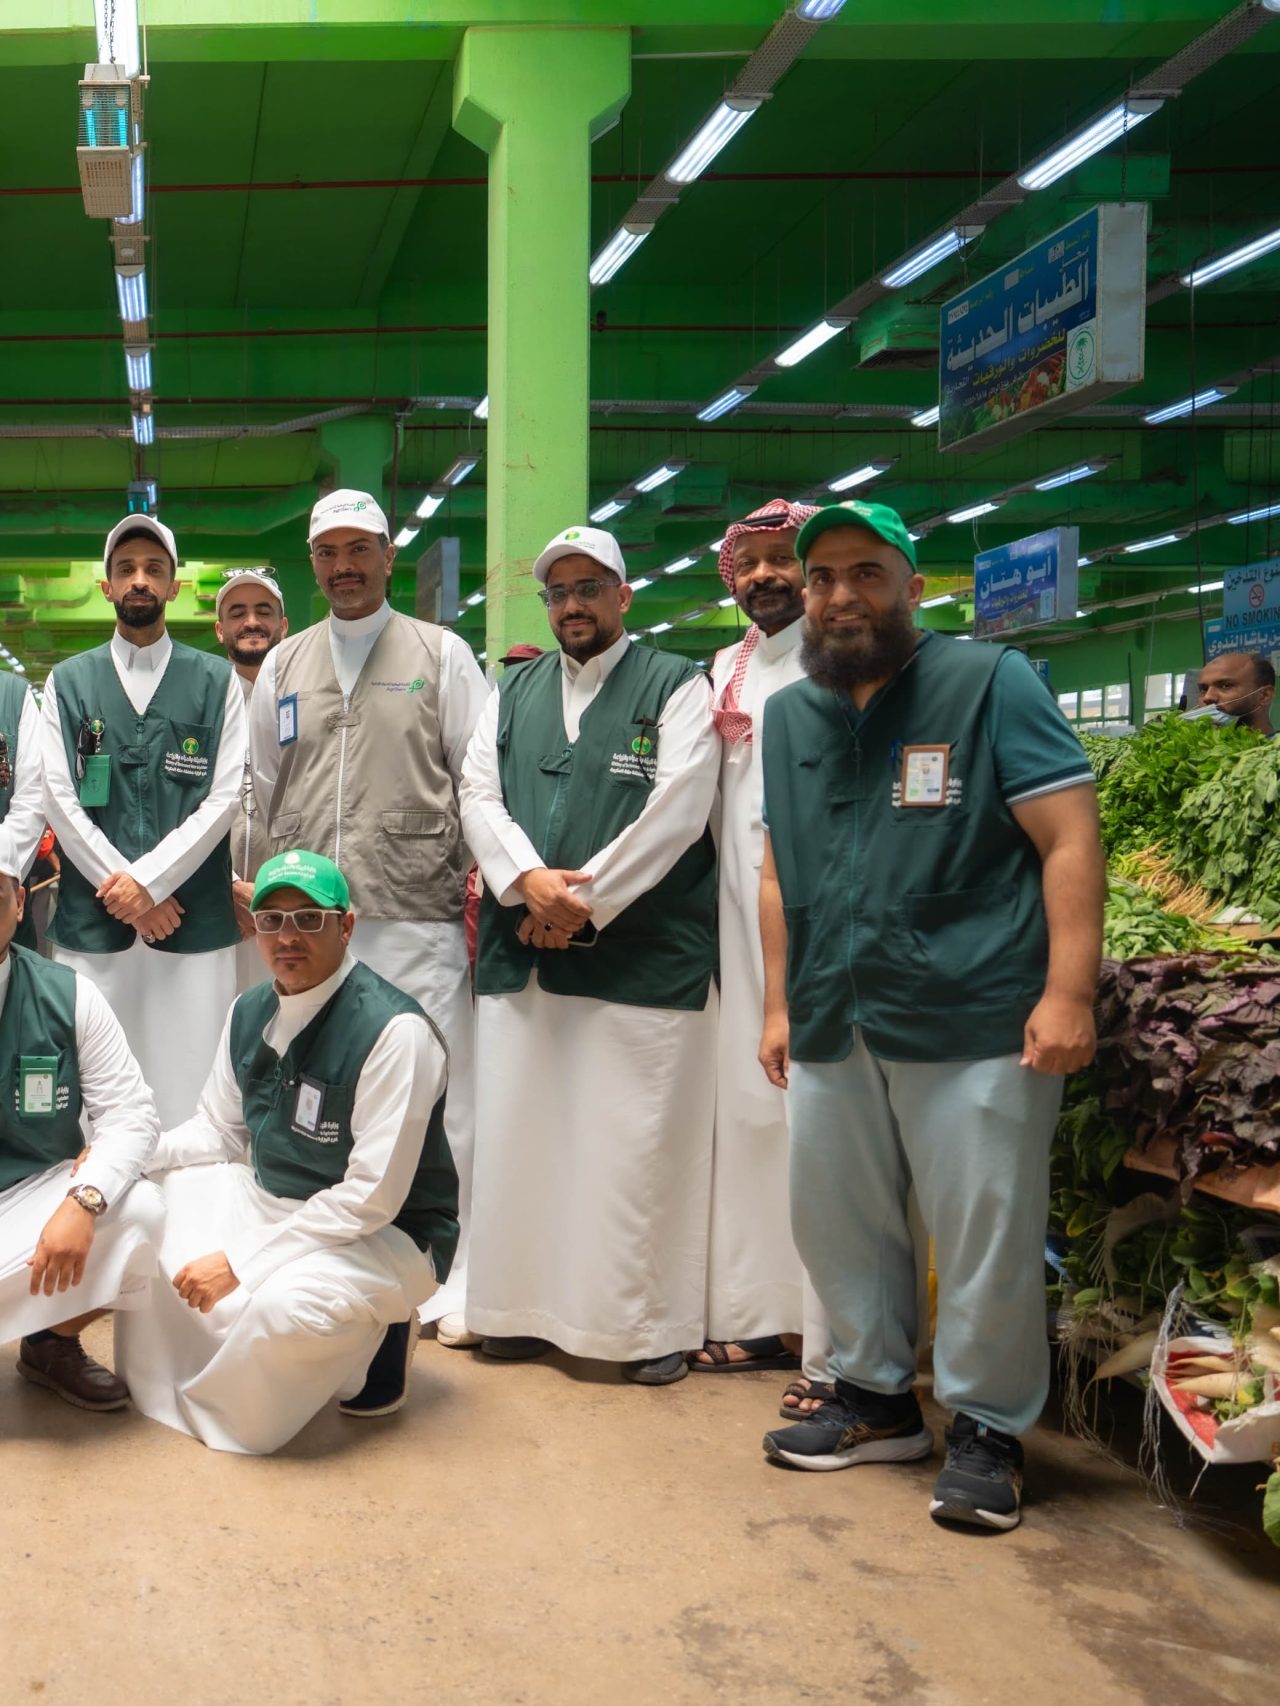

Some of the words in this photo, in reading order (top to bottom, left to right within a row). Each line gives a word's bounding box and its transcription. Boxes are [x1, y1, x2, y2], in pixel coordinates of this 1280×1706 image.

[1018, 256, 1090, 334] الطيبات
[1026, 550, 1051, 586] أبو
[1225, 614, 1239, 628] NO
[1241, 606, 1280, 626] SMOKIN
